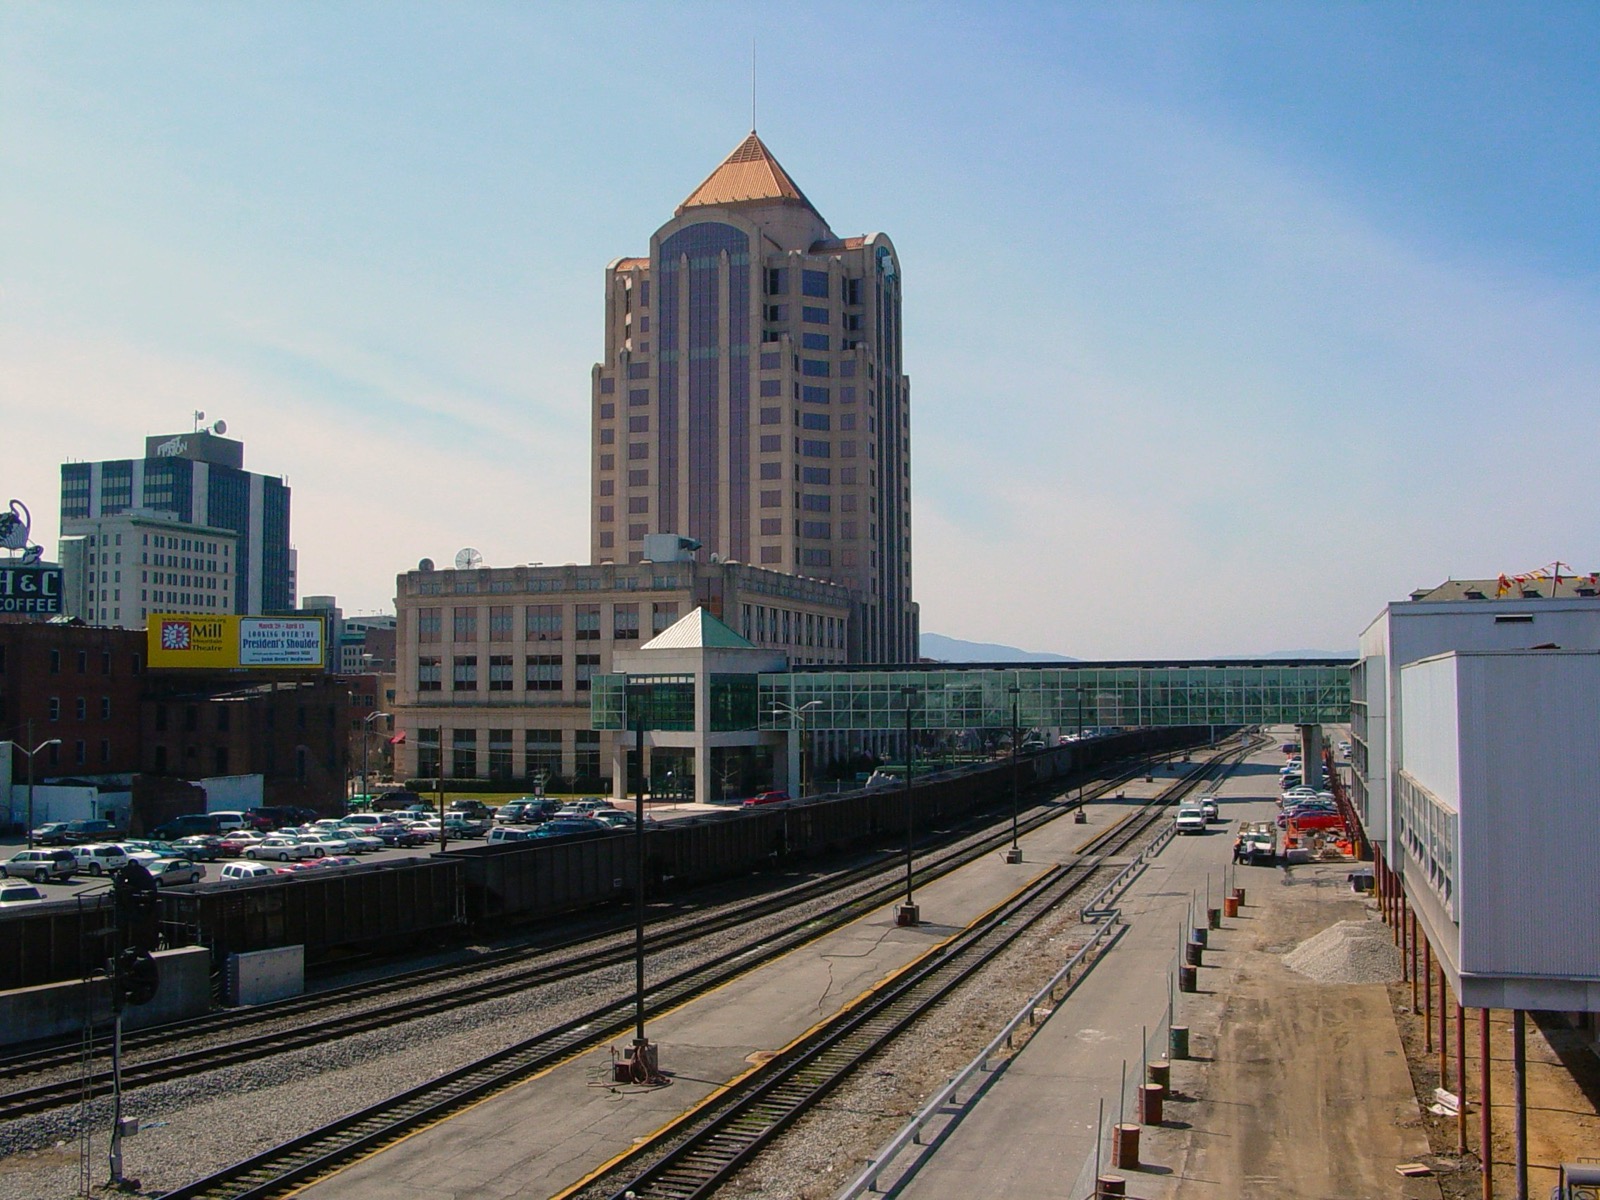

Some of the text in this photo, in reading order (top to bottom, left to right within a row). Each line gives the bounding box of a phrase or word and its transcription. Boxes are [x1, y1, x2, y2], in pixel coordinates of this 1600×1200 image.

[193, 624, 222, 637] Mill
[243, 639, 319, 648] President's Shoulder
